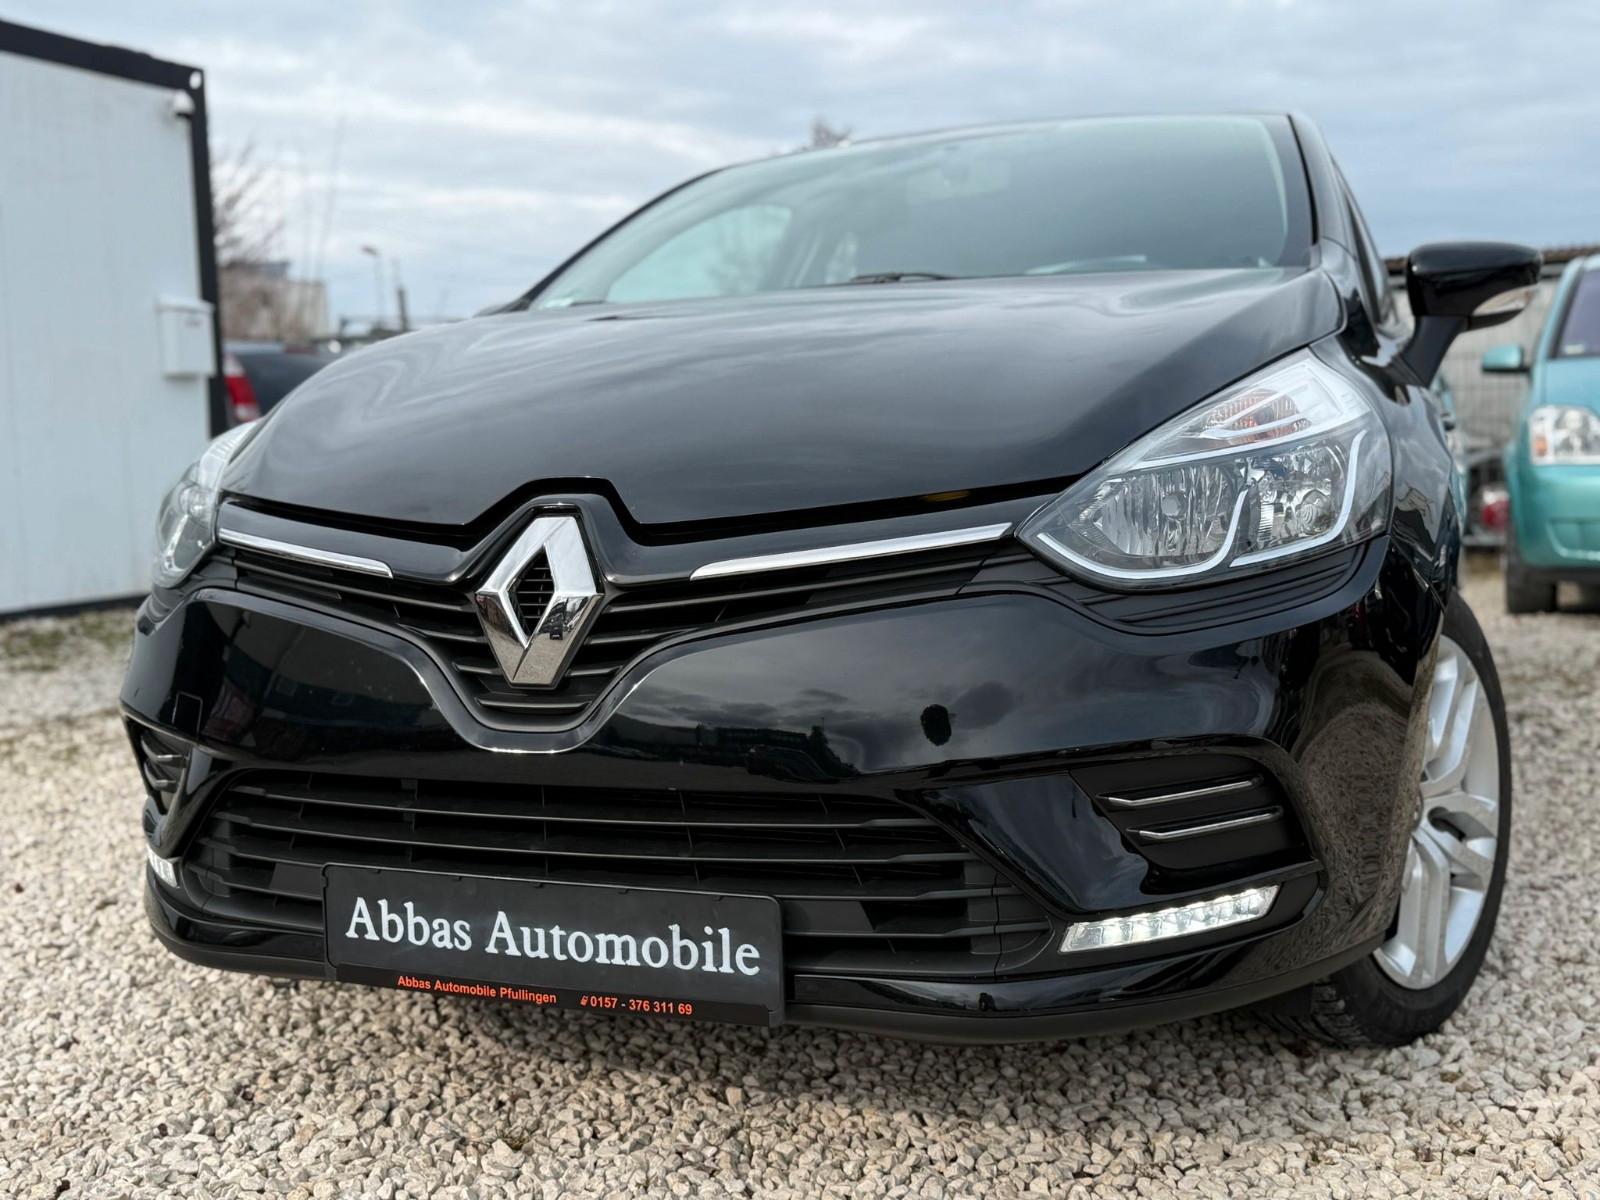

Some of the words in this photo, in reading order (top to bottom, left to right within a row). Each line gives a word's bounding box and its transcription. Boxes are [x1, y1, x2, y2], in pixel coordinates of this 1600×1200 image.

[344, 896, 473, 952] Abbas
[485, 910, 761, 976] Automobile
[398, 975, 431, 990] Abbas
[434, 979, 497, 998] Automobile
[499, 987, 557, 1005] Pfullingen
[590, 995, 618, 1009] 0157
[629, 999, 650, 1012] 376
[653, 1001, 674, 1014] 311
[677, 1002, 693, 1016] 69
